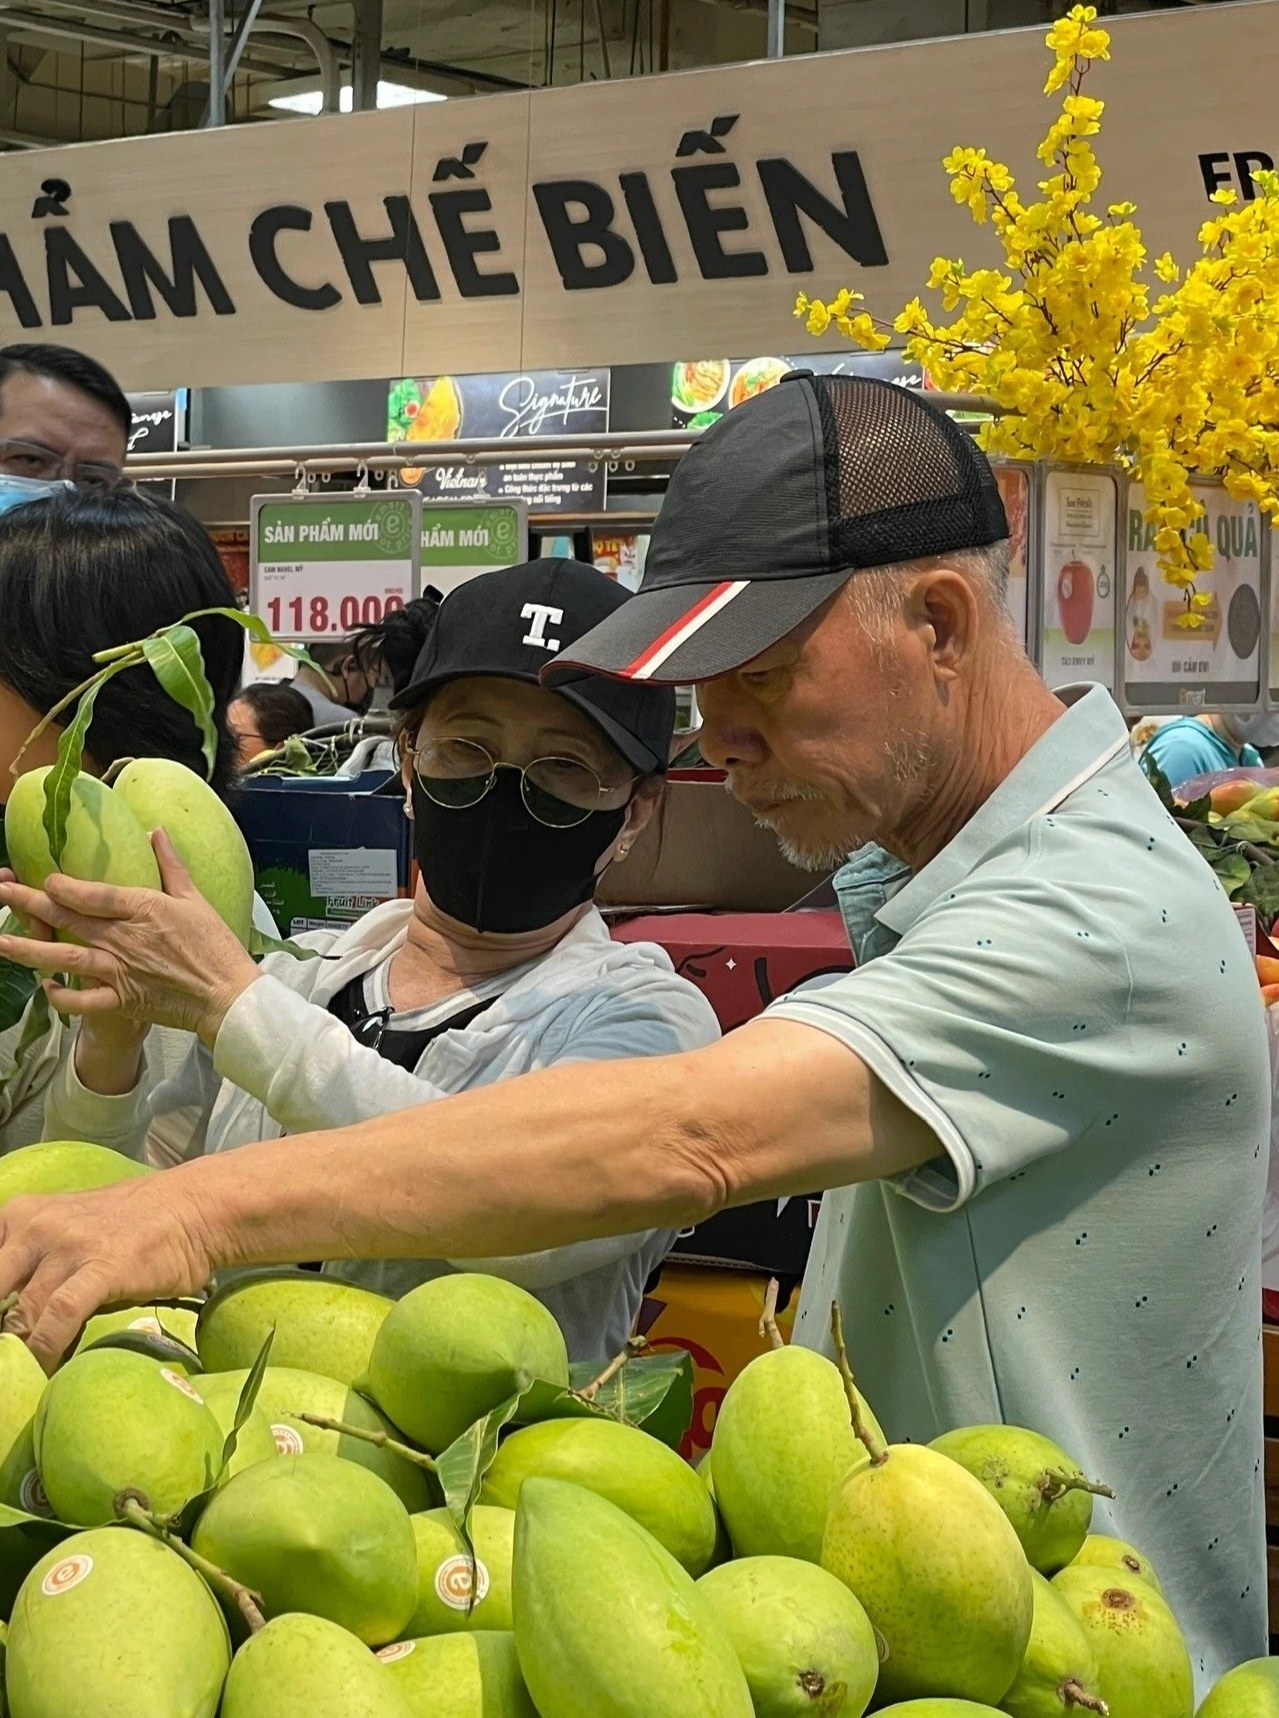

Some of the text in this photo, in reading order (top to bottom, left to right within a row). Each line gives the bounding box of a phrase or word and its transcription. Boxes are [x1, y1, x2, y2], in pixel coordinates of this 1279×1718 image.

[249, 141, 520, 311] CHẾ
[532, 114, 890, 291] BIẾN
[499, 376, 607, 438] Signature
[264, 520, 295, 544] SẢN
[299, 516, 344, 543] PHẨM
[349, 518, 379, 542] MỚI
[421, 522, 455, 547] HẨM
[459, 525, 489, 547] MỚI
[1217, 502, 1258, 562] QUẢ
[268, 595, 405, 633] 118.000
